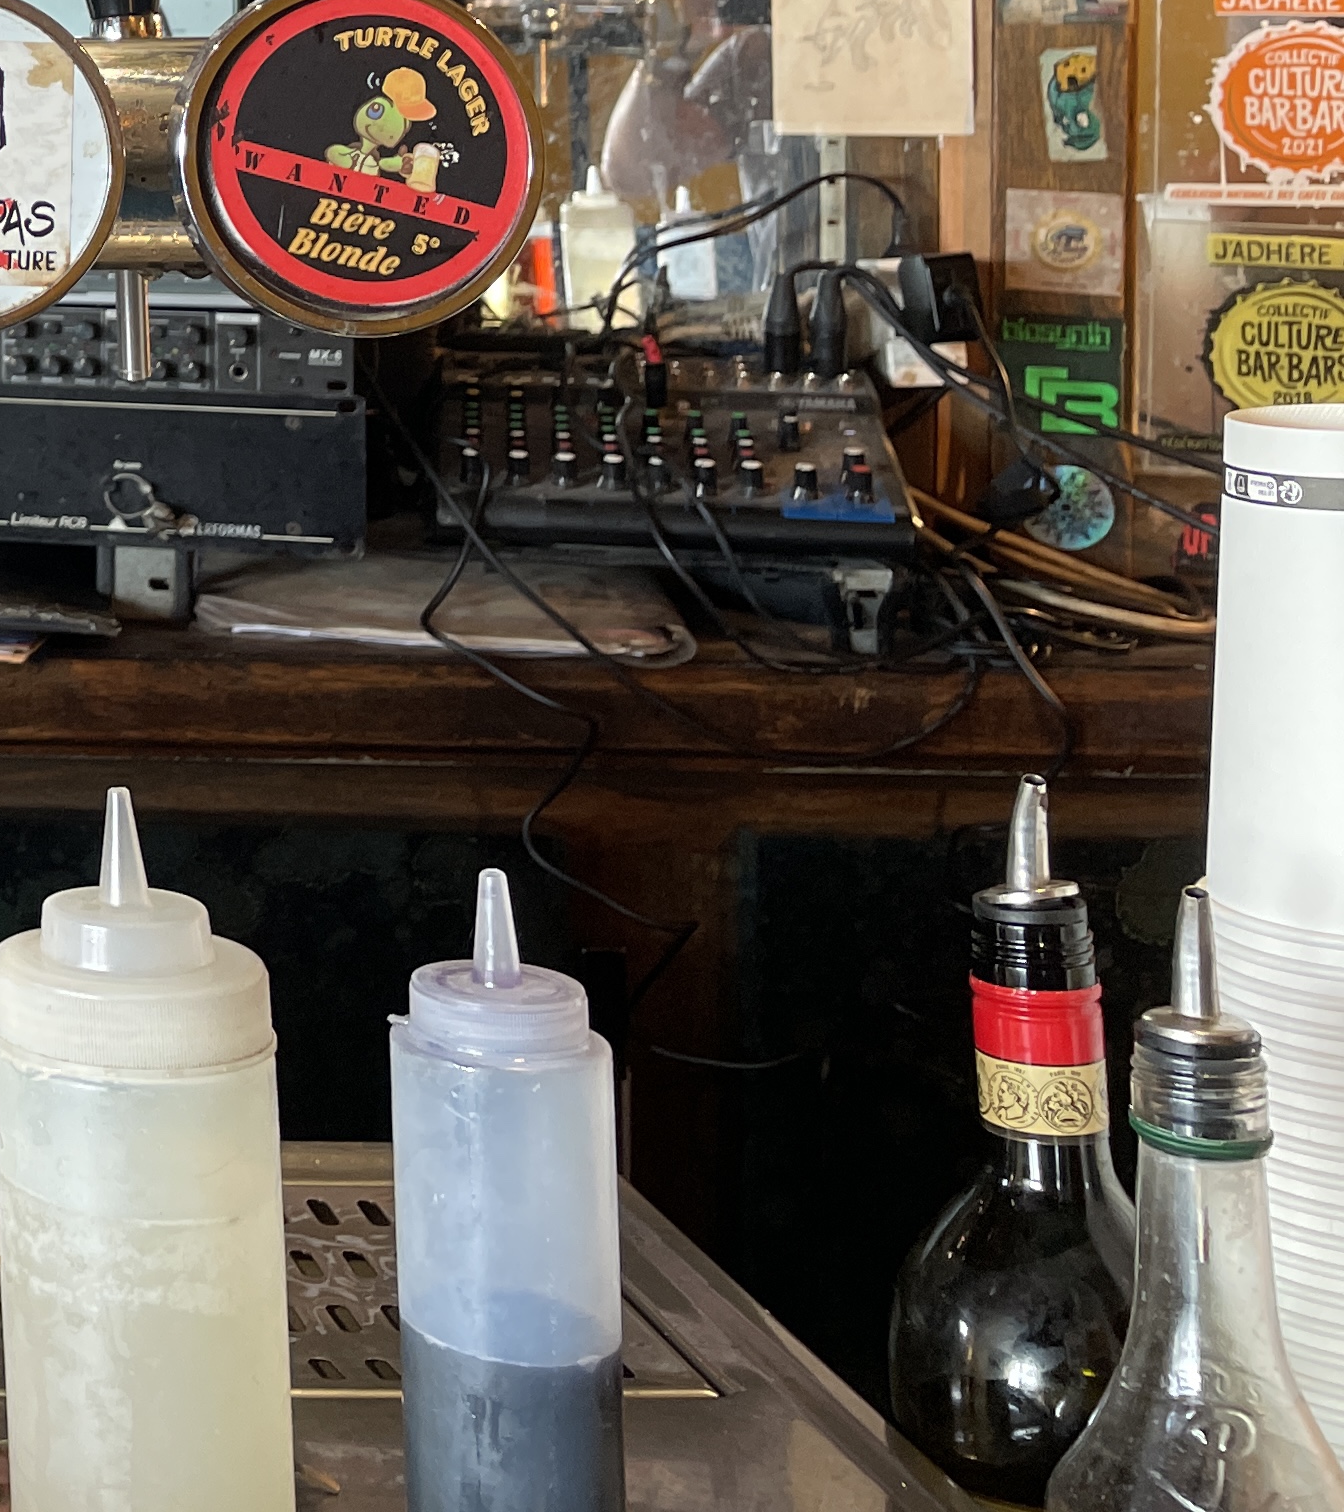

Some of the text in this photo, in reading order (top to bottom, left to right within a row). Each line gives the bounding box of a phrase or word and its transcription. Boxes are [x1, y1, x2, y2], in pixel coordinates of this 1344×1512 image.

[1265, 48, 1341, 67] COLLECTIF
[333, 27, 492, 137] TURTLE LAGER
[1249, 66, 1344, 98] CULTUR
[1282, 137, 1324, 156] 2021
[245, 148, 472, 226] WANTED
[310, 197, 396, 240] Bière
[287, 227, 402, 276] Blonde
[411, 233, 441, 255] 5°
[1256, 302, 1332, 320] COLLECTIF
